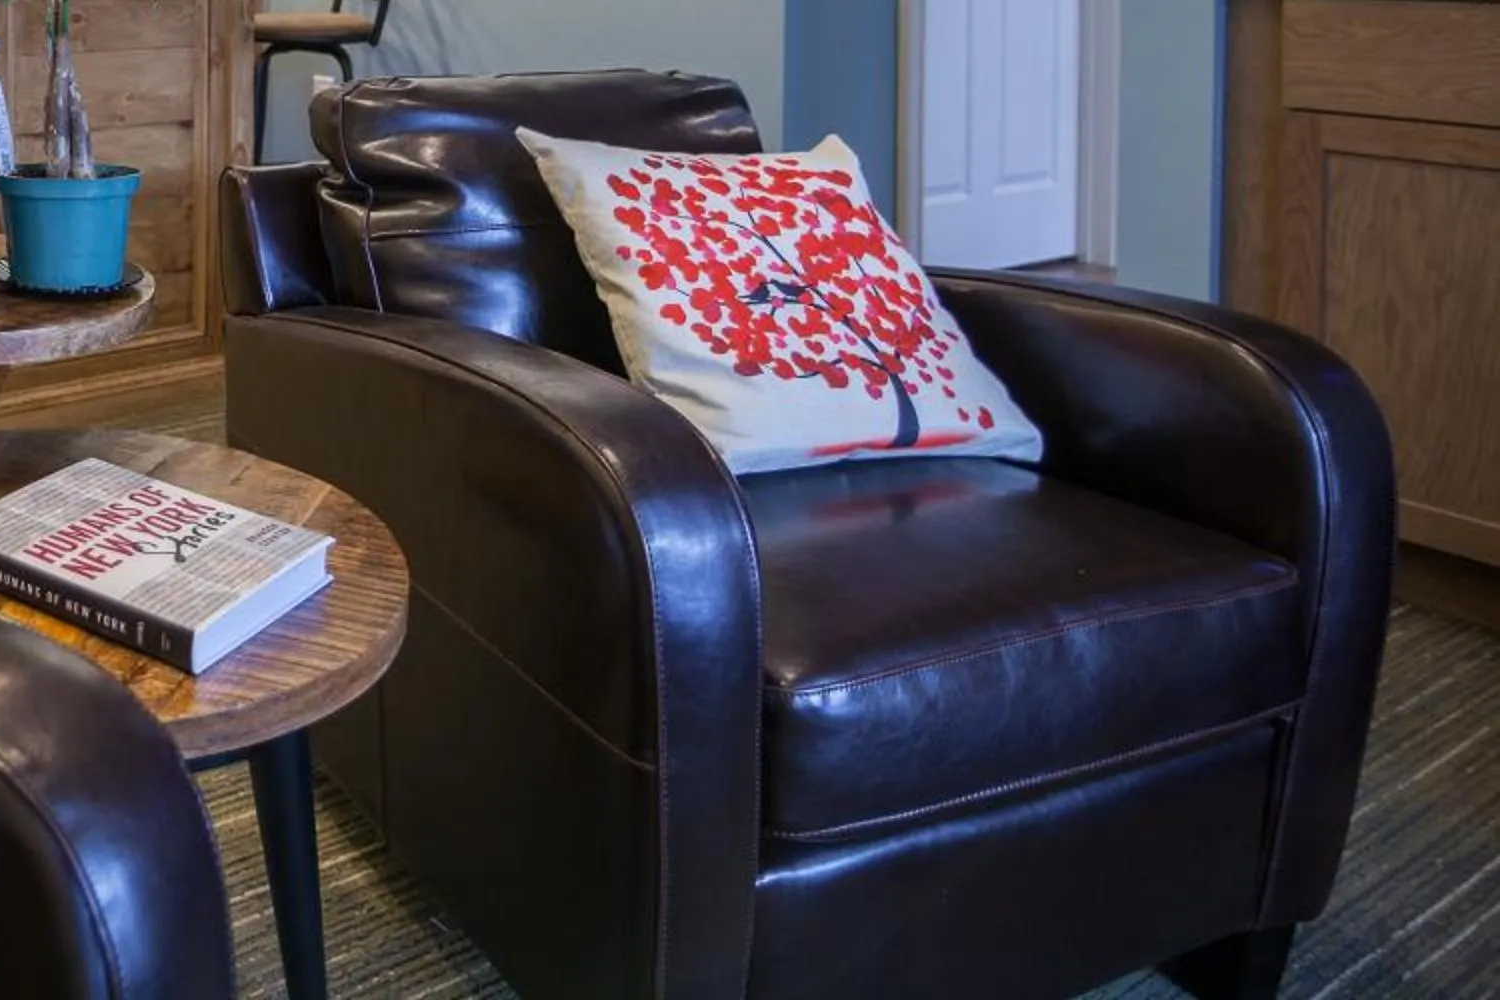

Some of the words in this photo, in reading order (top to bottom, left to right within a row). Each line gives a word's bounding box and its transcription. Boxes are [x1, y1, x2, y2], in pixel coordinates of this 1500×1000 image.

[23, 502, 143, 564] HUMANS
[129, 485, 171, 507] OF
[61, 532, 139, 580] NEW
[127, 497, 217, 539] YORK
[44, 590, 62, 608] OF
[65, 599, 91, 620] NEW
[94, 610, 129, 634] YORK
